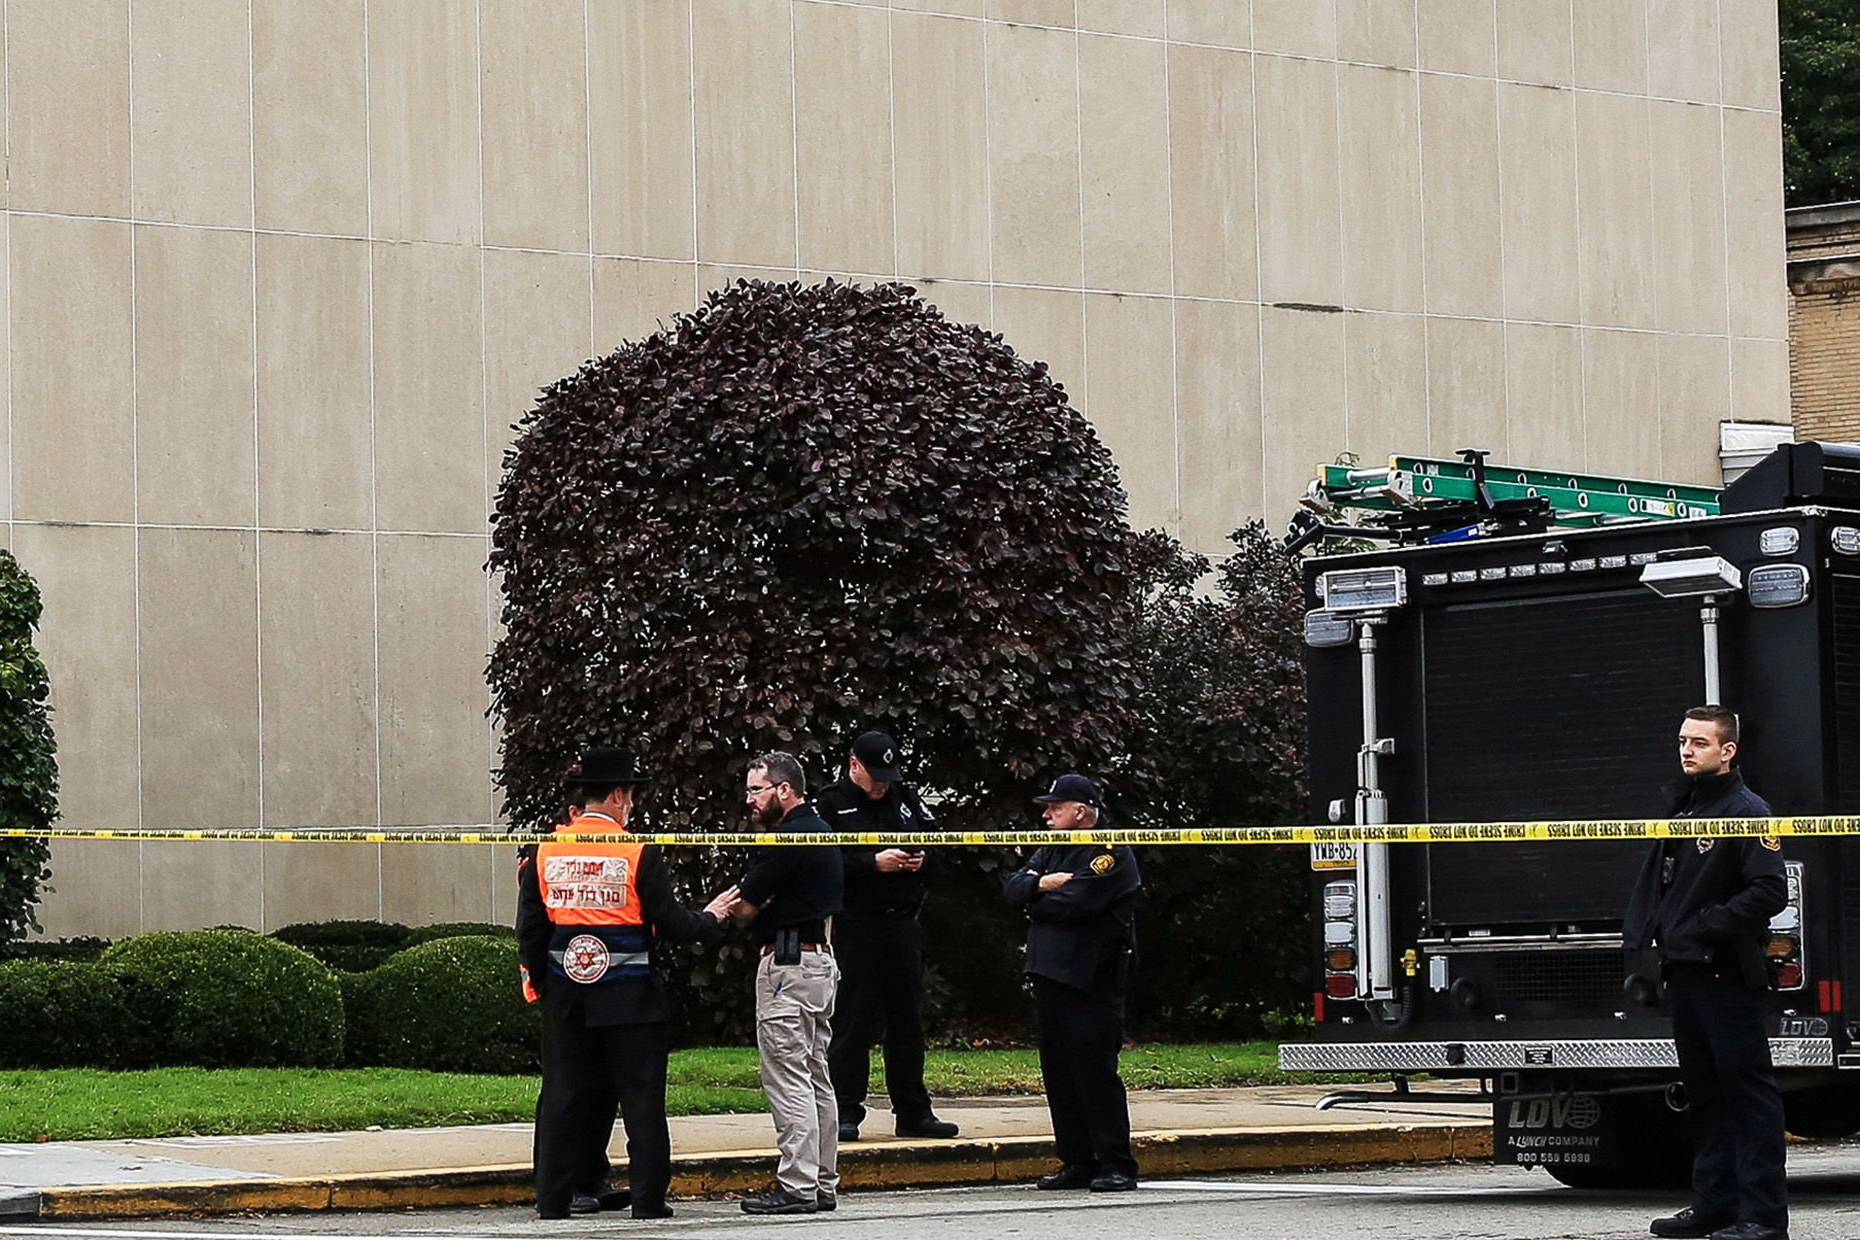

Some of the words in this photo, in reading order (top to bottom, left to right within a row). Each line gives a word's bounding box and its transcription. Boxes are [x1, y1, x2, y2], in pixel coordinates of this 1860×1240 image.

[1508, 1097, 1573, 1128] LDV
[1507, 1135, 1516, 1146] A
[1516, 1135, 1547, 1148] LYNCH
[1548, 1136, 1600, 1146] COMPANY
[1516, 1152, 1538, 1163] 800
